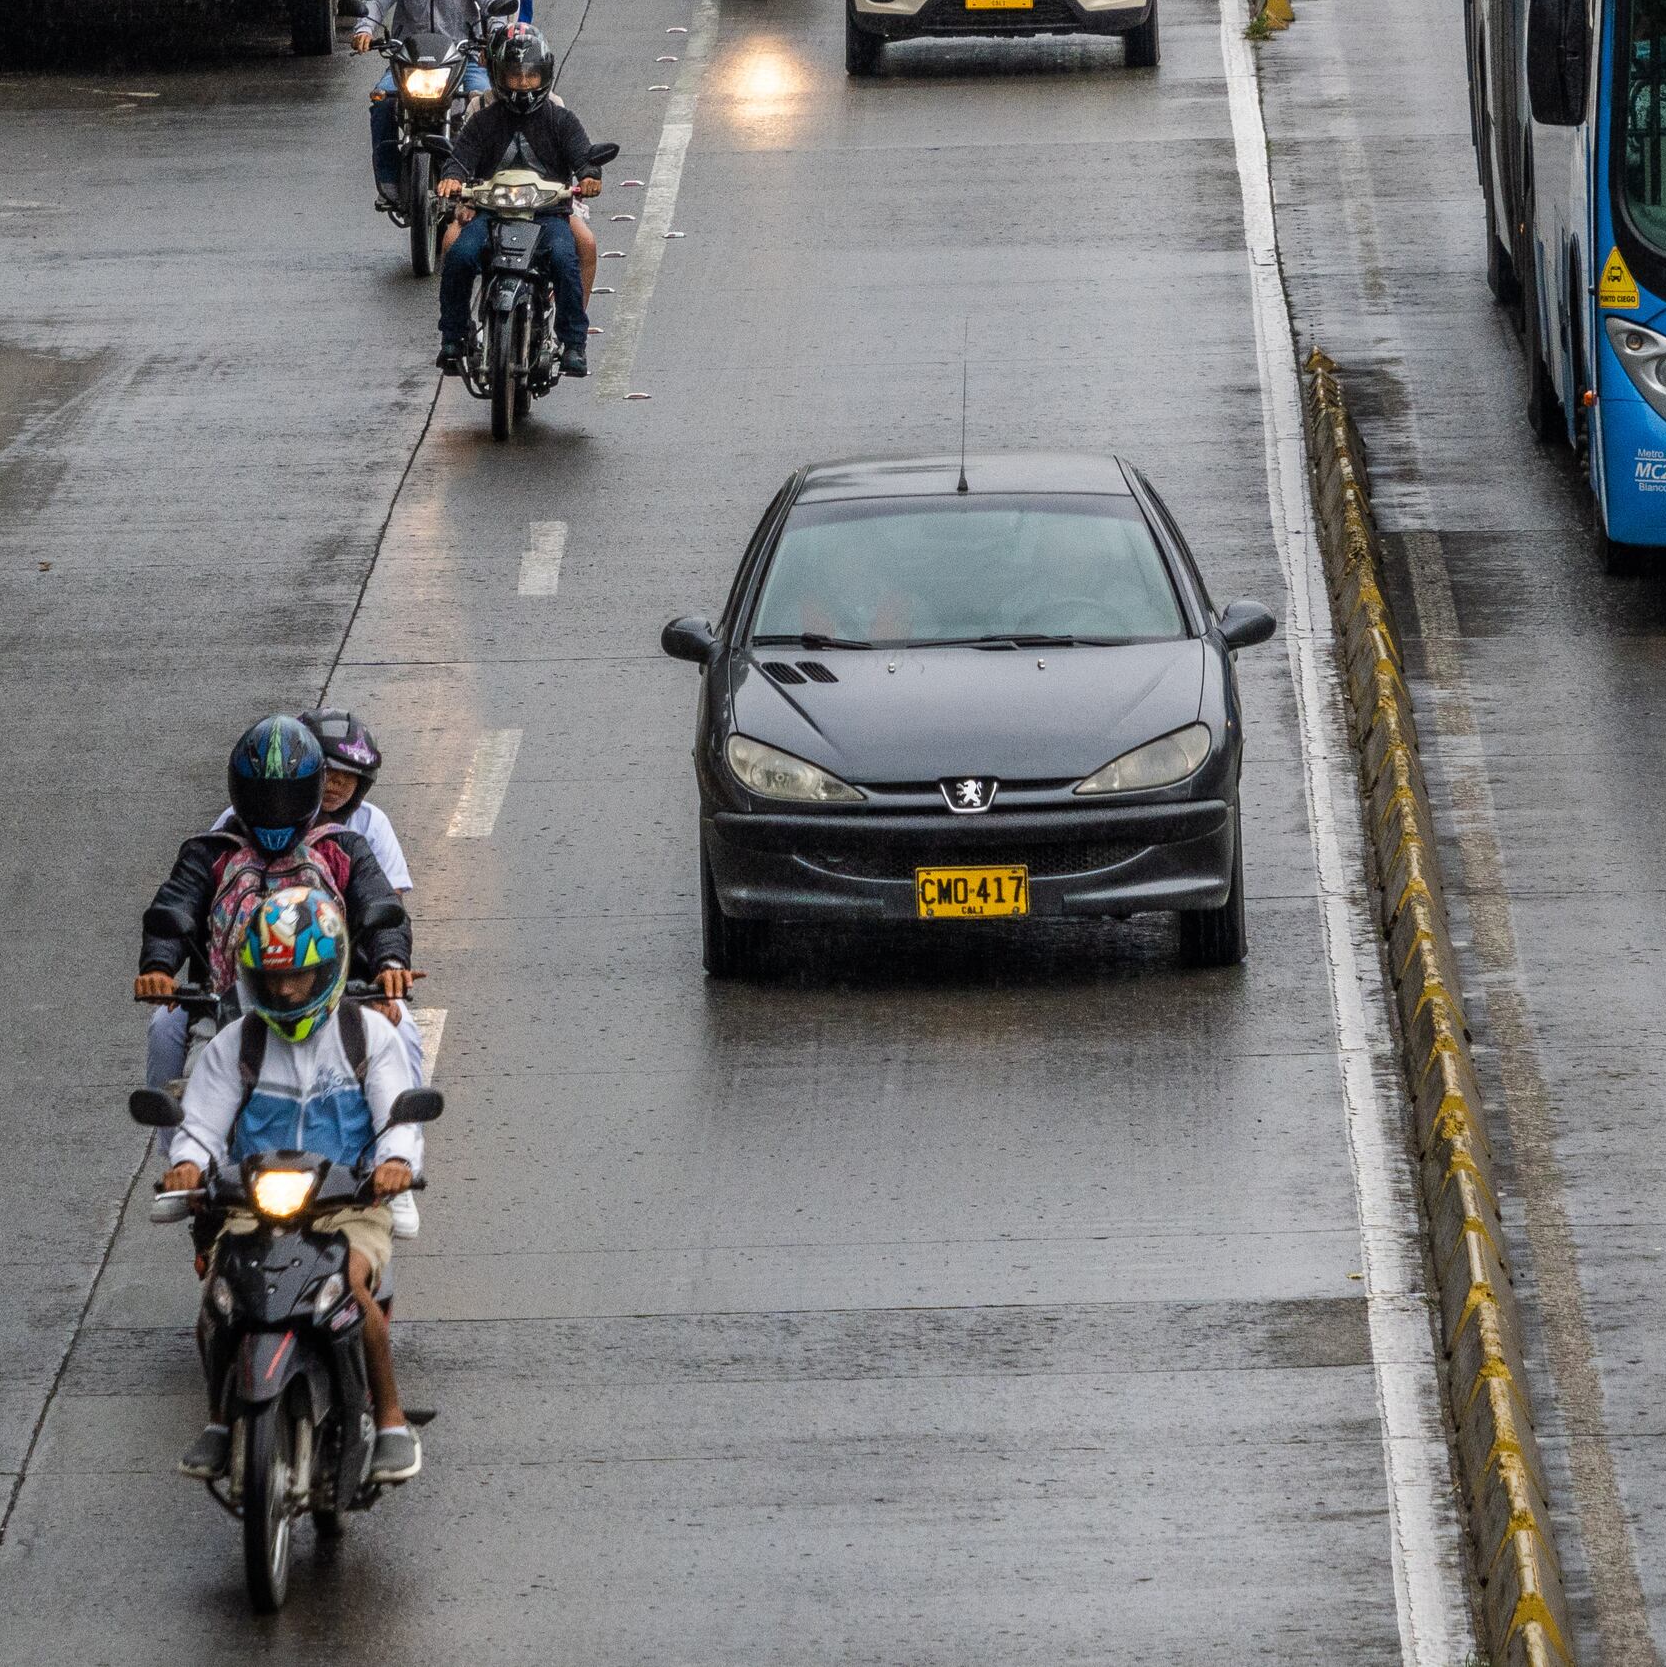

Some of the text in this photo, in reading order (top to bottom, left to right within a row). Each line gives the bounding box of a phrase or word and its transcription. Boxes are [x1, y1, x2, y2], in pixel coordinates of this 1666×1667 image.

[1619, 295, 1636, 303] CIEGO
[1637, 448, 1664, 459] Metro
[920, 875, 1024, 905] CMO 417
[961, 906, 984, 915] CALI
